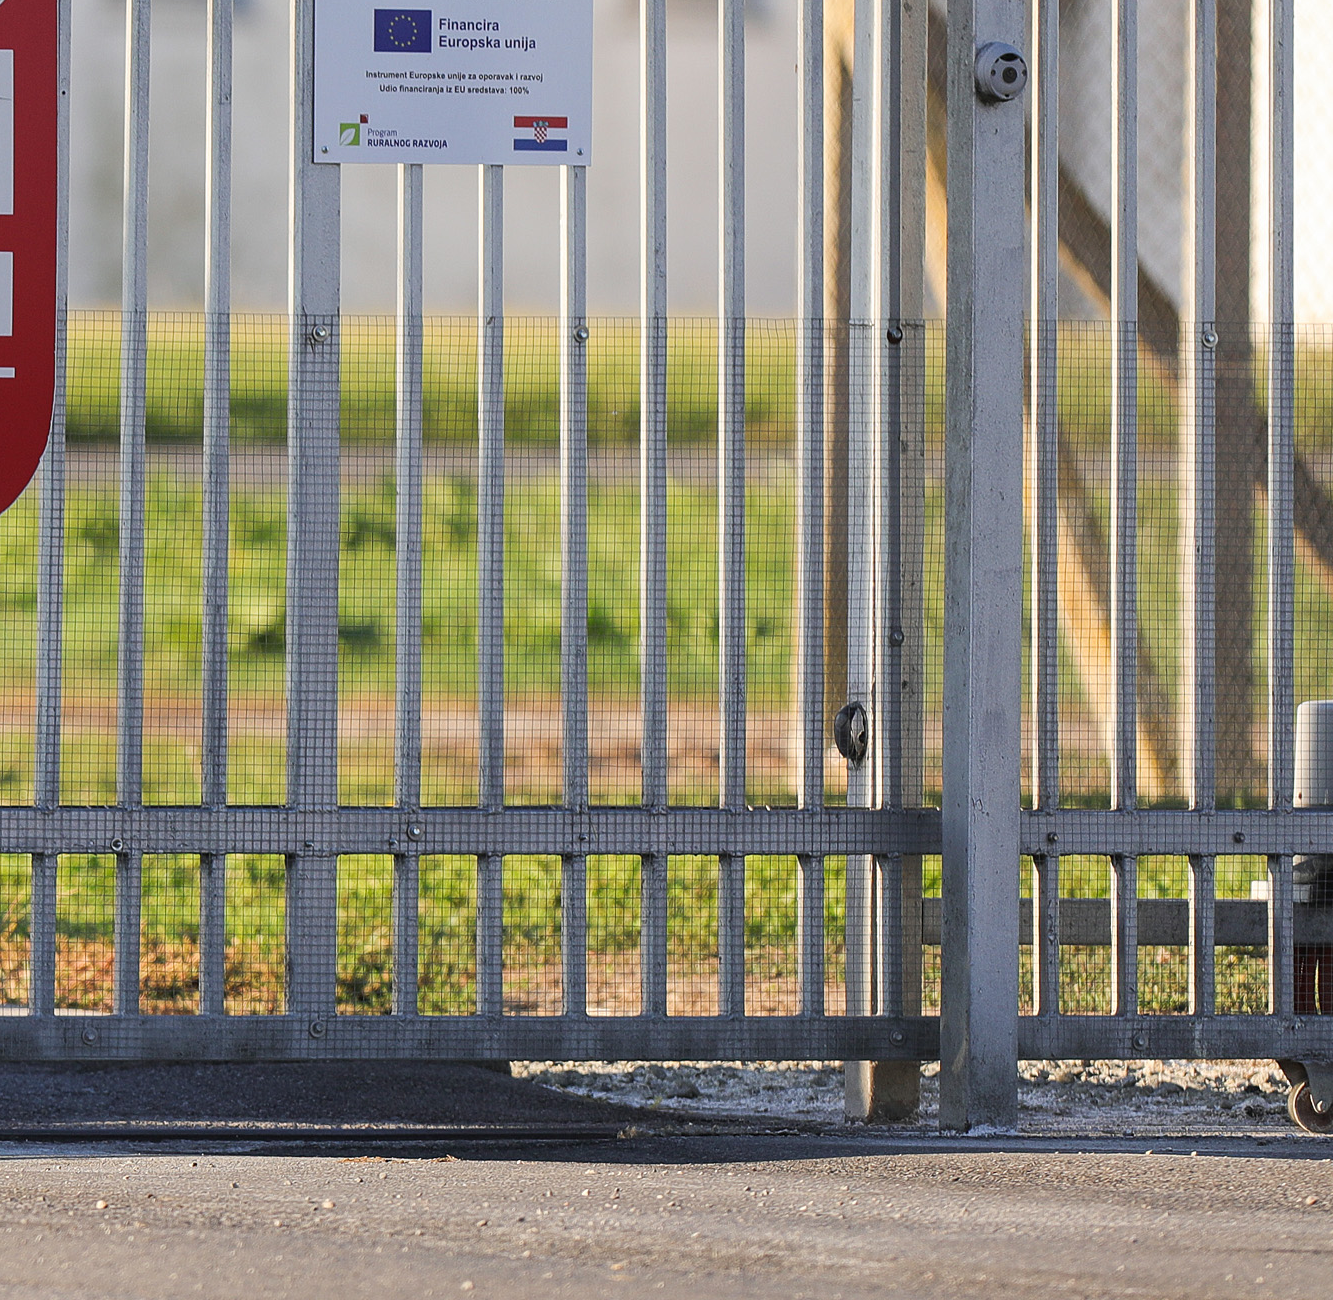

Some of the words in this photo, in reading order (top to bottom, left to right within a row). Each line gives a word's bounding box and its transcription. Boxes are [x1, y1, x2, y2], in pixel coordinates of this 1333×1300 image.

[439, 18, 499, 31] Financira
[439, 35, 500, 50] Europska
[505, 36, 535, 51] unija
[365, 70, 407, 78] Instrument
[409, 71, 445, 80] Europske
[447, 72, 466, 81] unije
[478, 72, 513, 81] oporavak
[520, 73, 543, 82] razvoj
[379, 84, 397, 92] Udio
[399, 84, 443, 94] financiranja
[445, 85, 452, 93] iz
[454, 85, 465, 93] EU
[509, 86, 529, 94] 100%
[367, 128, 397, 139] Program
[367, 138, 410, 147] RURALNOG
[412, 139, 447, 149] RAZVOJA
